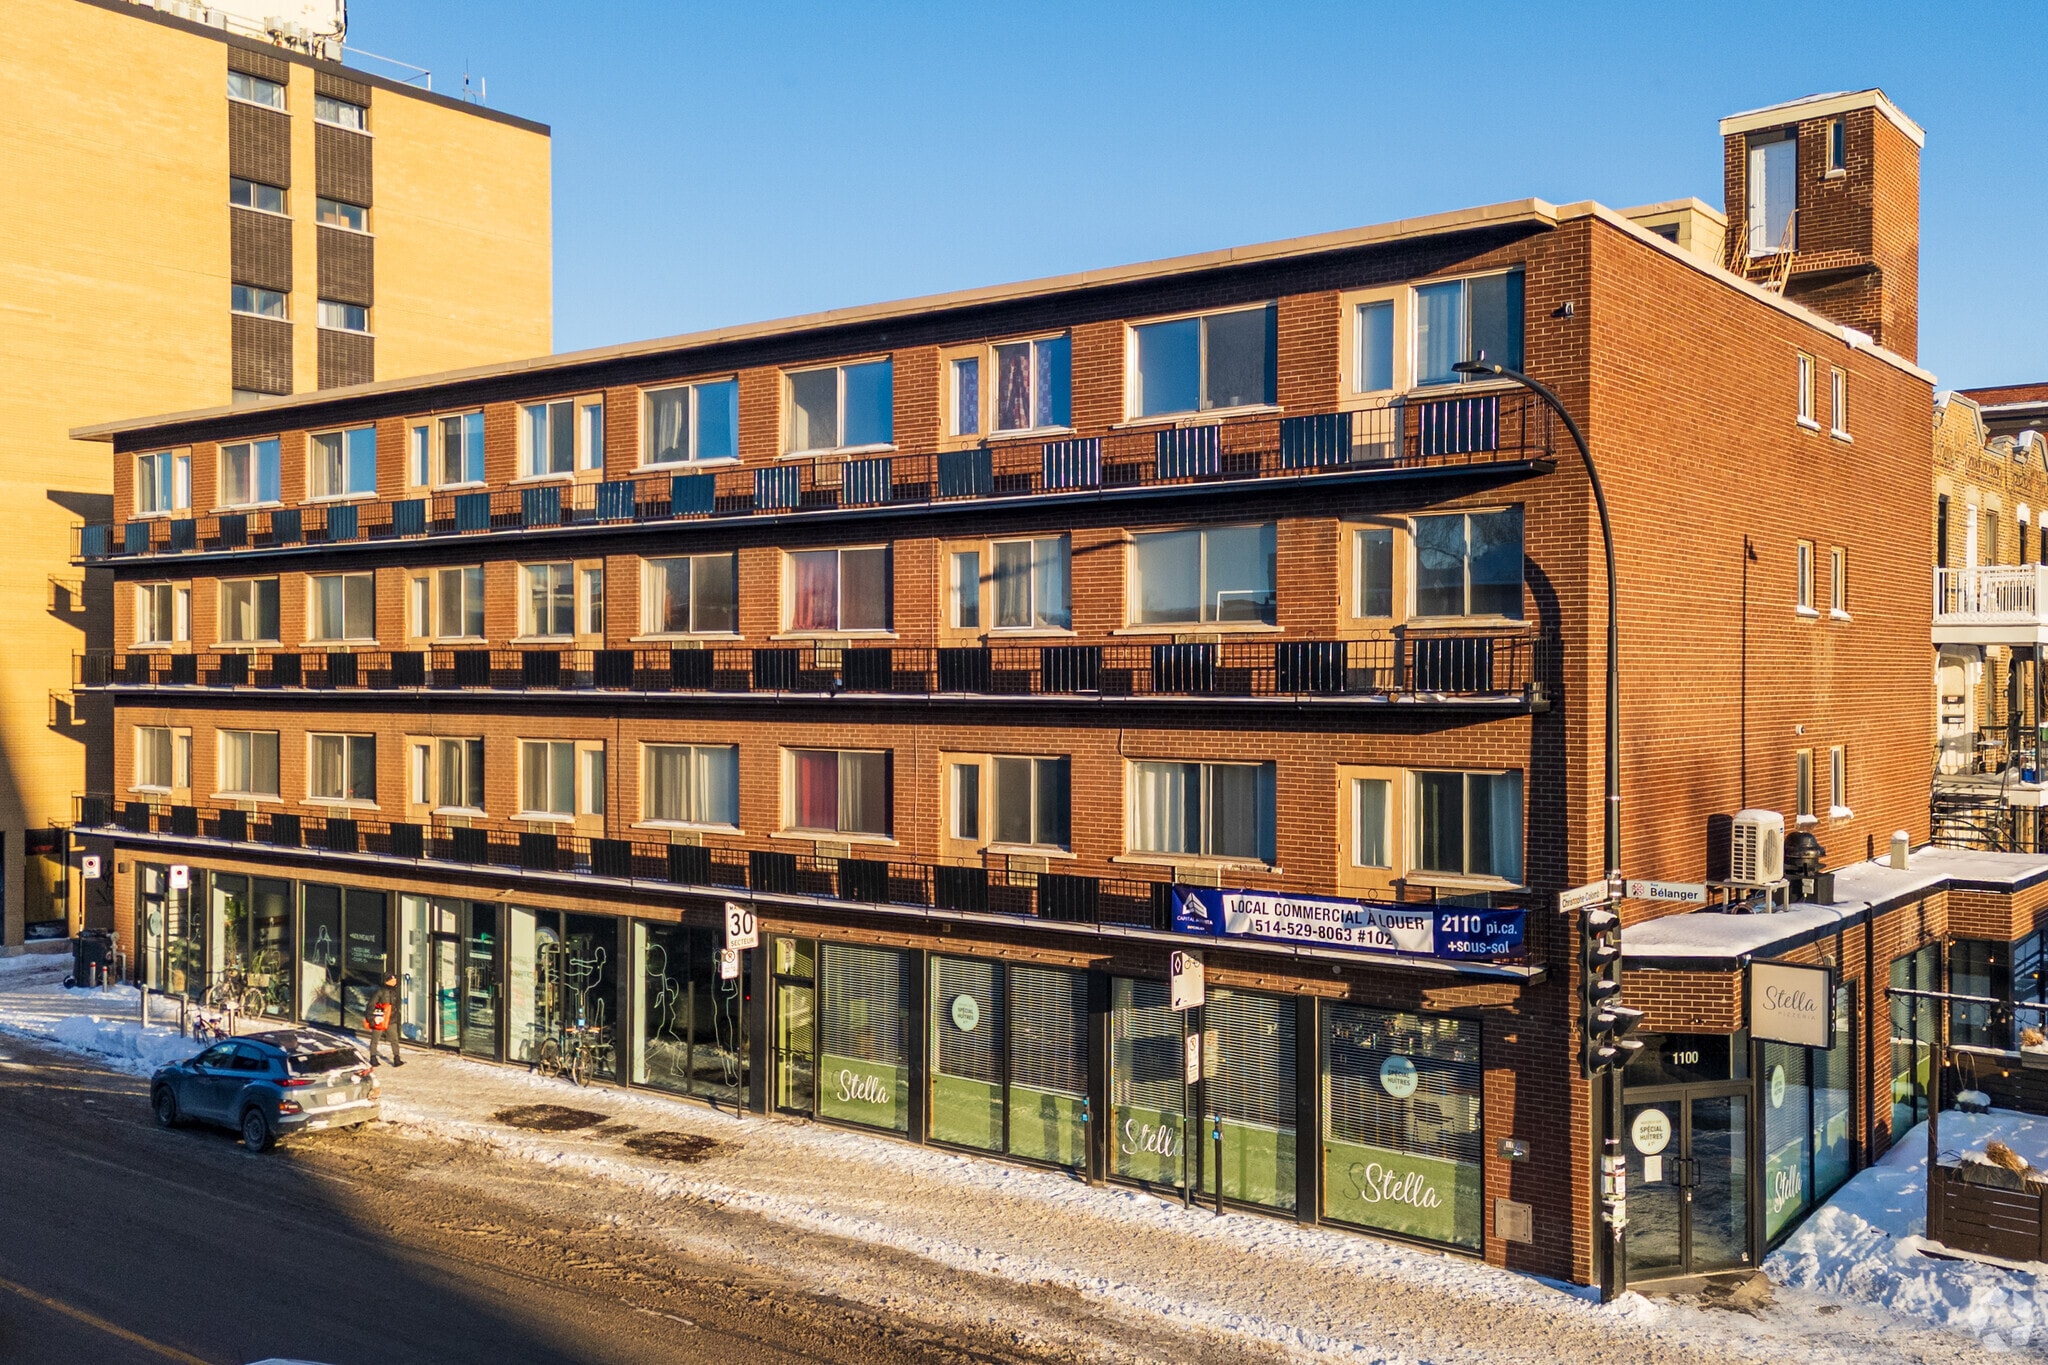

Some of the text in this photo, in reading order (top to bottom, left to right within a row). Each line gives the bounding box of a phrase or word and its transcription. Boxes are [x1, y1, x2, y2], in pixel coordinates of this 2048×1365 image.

[1650, 888, 1699, 901] Bélanger
[731, 910, 754, 936] 30
[1231, 899, 1270, 915] LOCAL
[1274, 902, 1363, 924] COMMERCIAL
[1378, 914, 1425, 931] LOUER
[1441, 914, 1518, 936] 2110 pi.ca.
[731, 937, 755, 947] SECTEUR
[1255, 919, 1393, 946] 514-529-8063 #102
[1447, 940, 1510, 954] +sous-sol
[1762, 985, 1818, 1012] Stella
[1672, 1051, 1699, 1065] 1100
[837, 1069, 890, 1104] Stella
[1122, 1118, 1185, 1158] Stella
[1639, 1125, 1663, 1134] SPÉCIAL
[1362, 1162, 1443, 1208] Stella
[1774, 1164, 1803, 1214] Stella
